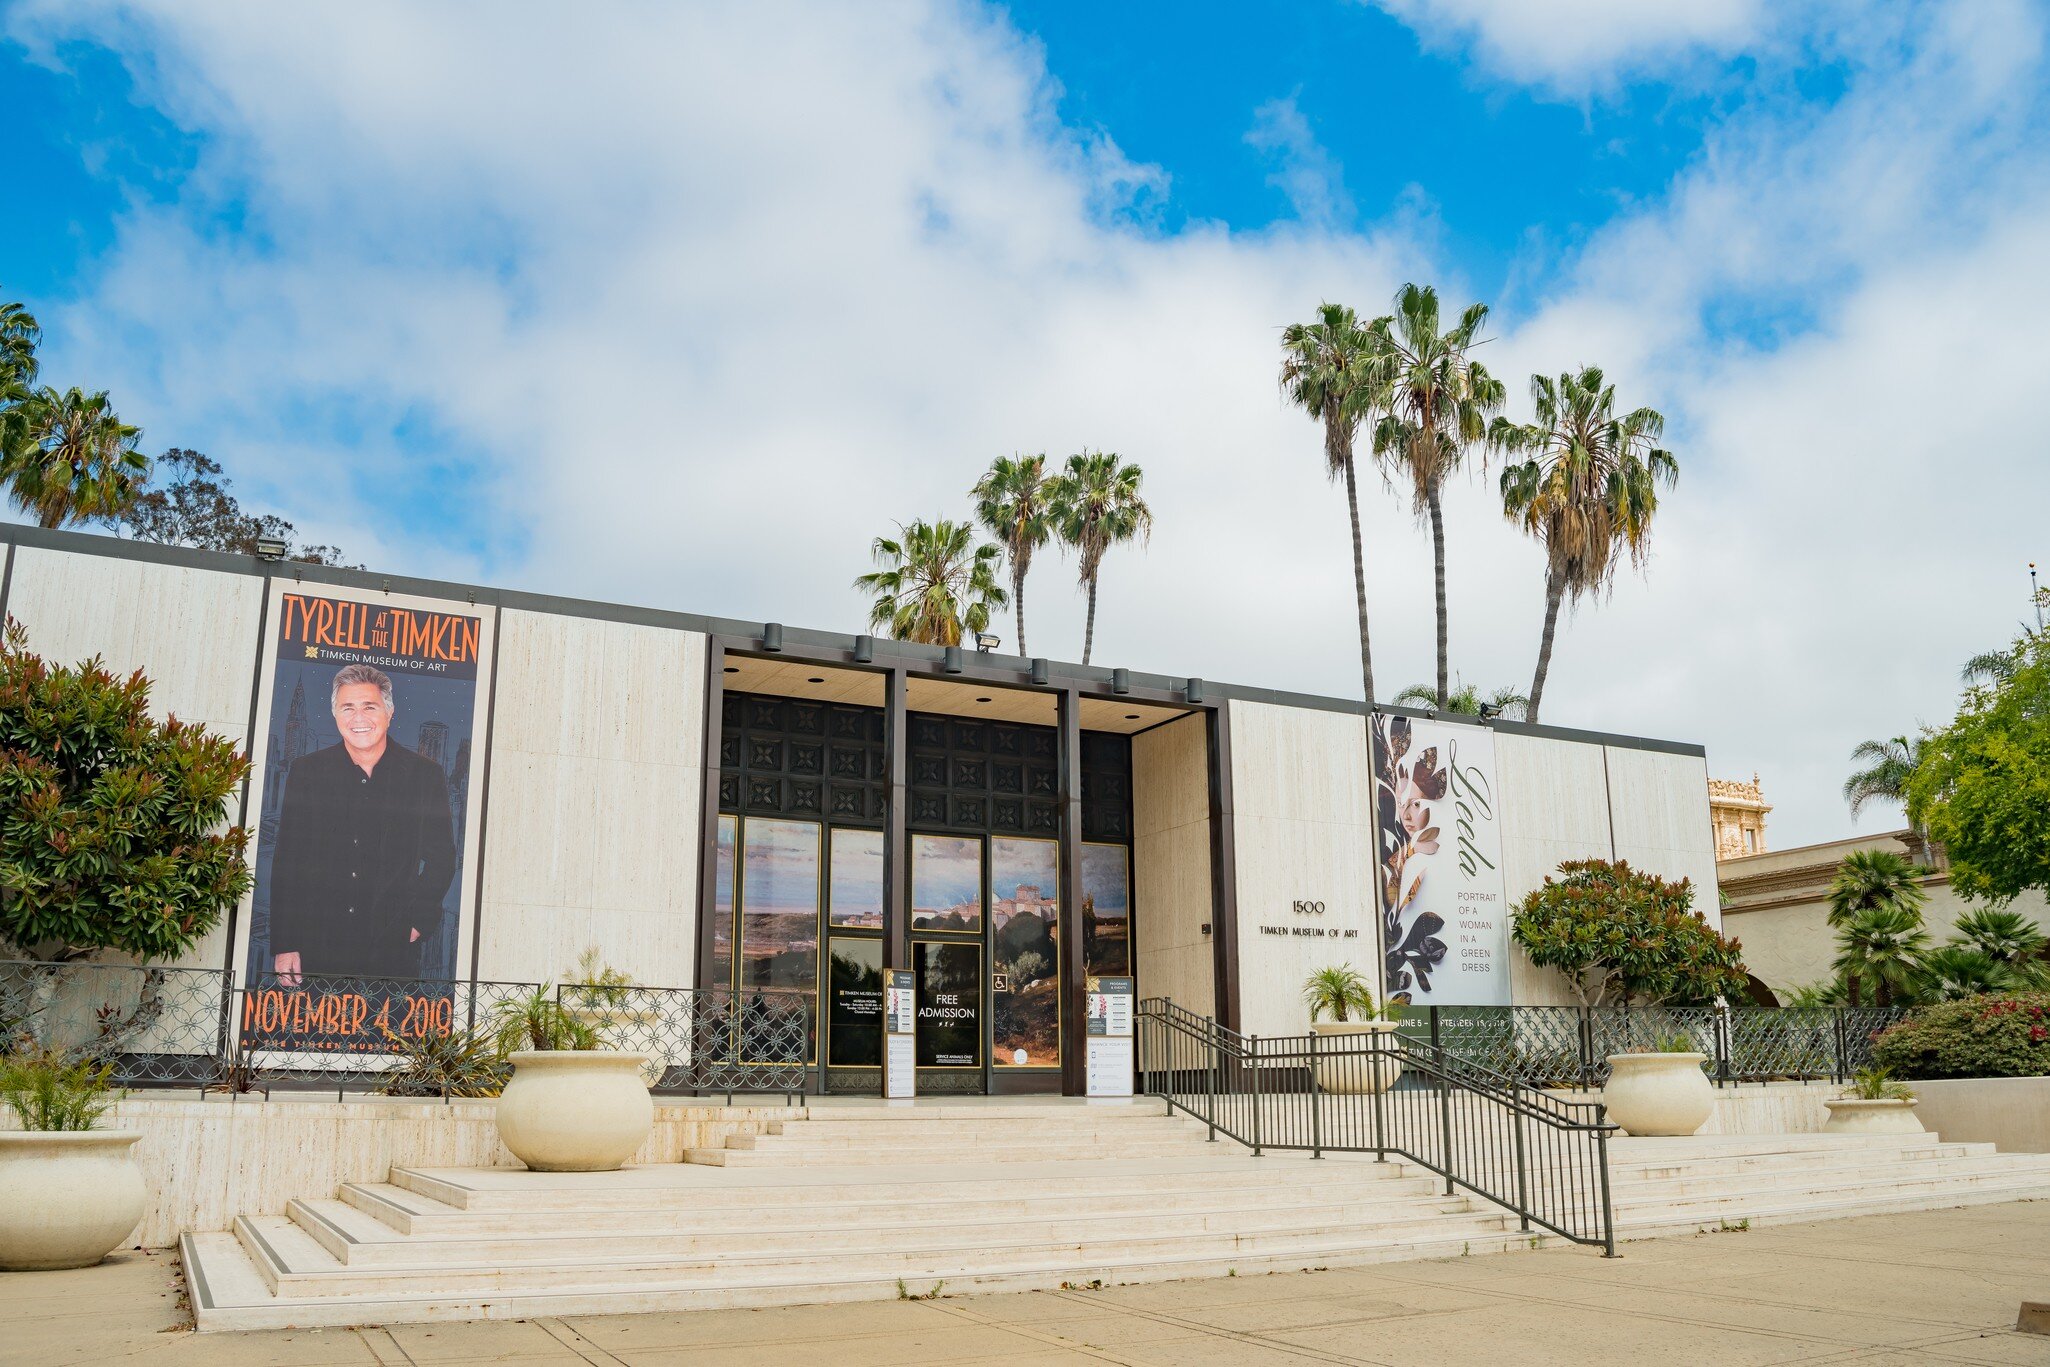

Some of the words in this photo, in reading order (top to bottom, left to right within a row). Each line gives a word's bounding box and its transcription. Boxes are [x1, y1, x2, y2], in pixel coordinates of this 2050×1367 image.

[284, 594, 370, 650] TYRELL
[375, 611, 388, 629] AT
[371, 629, 389, 648] THE
[390, 609, 479, 664] TIMKEN
[320, 649, 360, 661] TIMKEN
[362, 655, 408, 668] MUSEUM
[410, 660, 425, 669] OF
[427, 662, 447, 672] ART
[1457, 892, 1497, 902] PORTRAIT
[1293, 900, 1326, 914] 1500
[1458, 906, 1470, 915] OF
[1472, 907, 1478, 915] A
[1459, 920, 1492, 930] WOMAN
[1259, 925, 1289, 936] TIMKEN
[1292, 927, 1325, 937] MUSEUM
[1328, 928, 1340, 938] OF
[1343, 929, 1359, 938] ART
[1460, 934, 1469, 943] IN
[1471, 935, 1477, 943] A
[1461, 948, 1491, 958] GREEN
[1461, 963, 1491, 972] DRESS
[936, 994, 958, 1005] FREE
[244, 990, 369, 1036] NOVEMBER
[918, 1007, 975, 1018] ADMISSION
[1396, 1018, 1416, 1027] JUNE
[1417, 1019, 1423, 1027] 5
